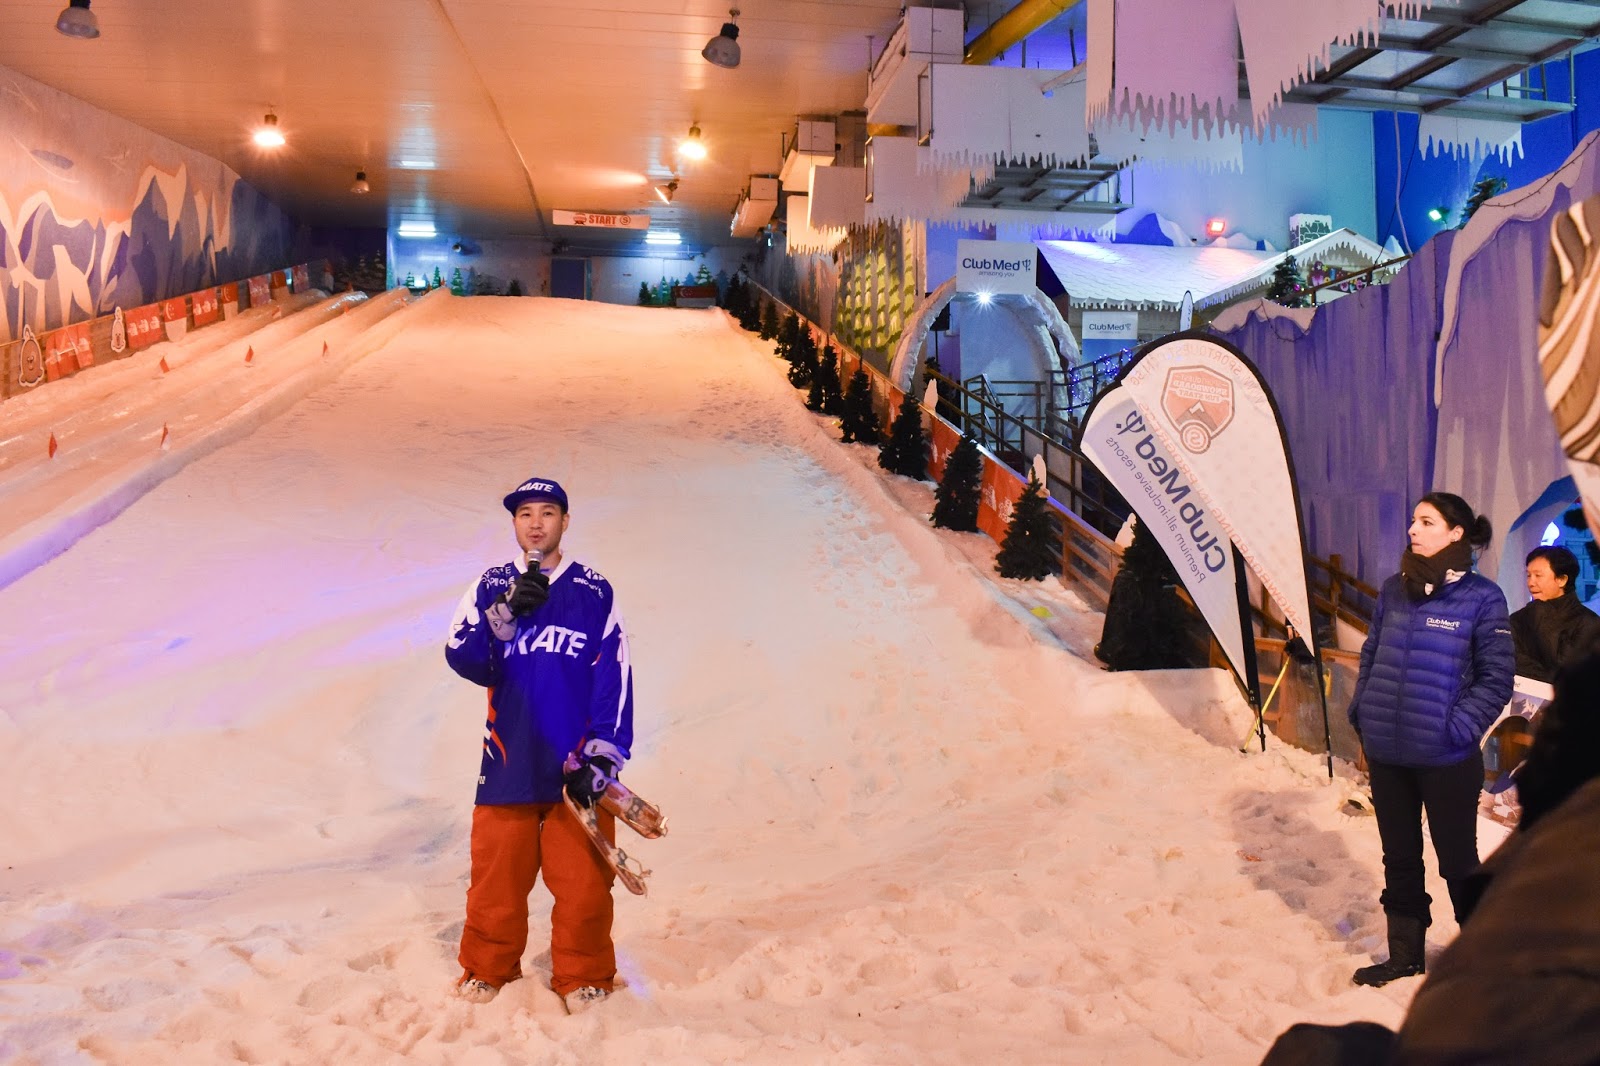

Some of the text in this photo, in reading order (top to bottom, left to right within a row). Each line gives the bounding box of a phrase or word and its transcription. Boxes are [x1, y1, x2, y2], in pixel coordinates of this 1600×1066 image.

[589, 215, 616, 225] START
[962, 258, 1020, 271] Club Med
[1089, 323, 1124, 331] Club Med
